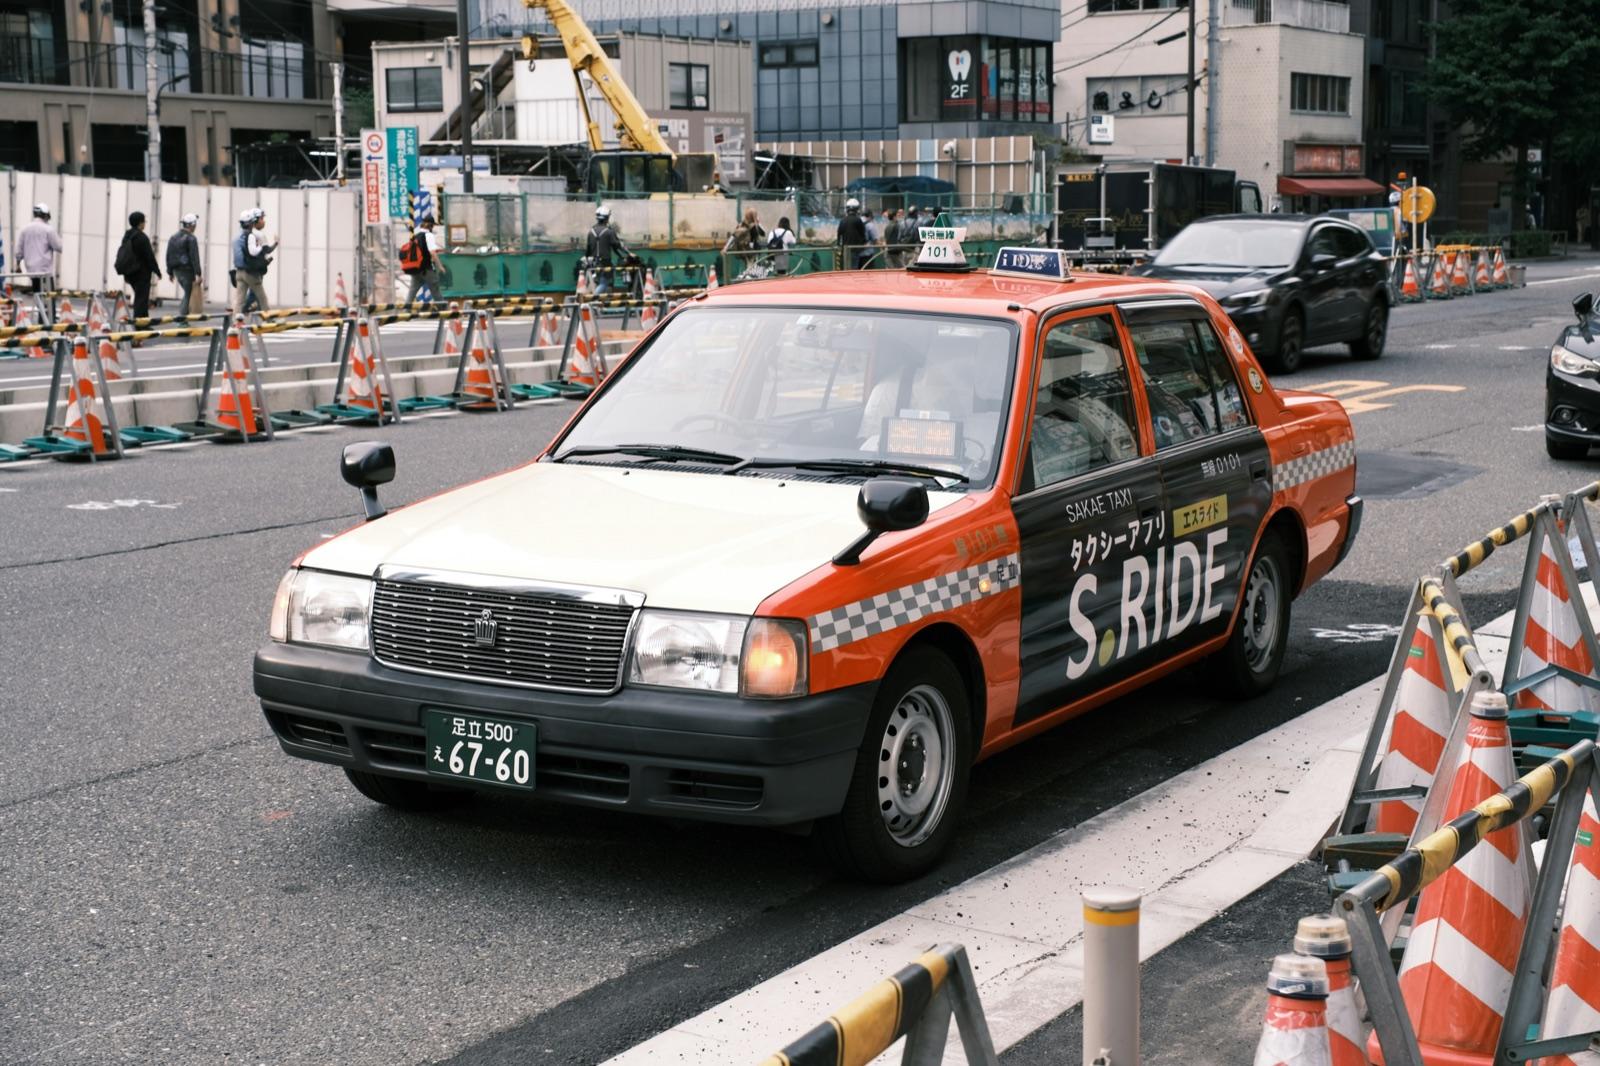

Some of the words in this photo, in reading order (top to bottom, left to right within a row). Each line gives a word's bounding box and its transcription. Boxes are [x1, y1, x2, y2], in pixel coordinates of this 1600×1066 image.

[951, 84, 969, 99] 2F
[927, 246, 948, 258] 101
[1065, 495, 1107, 524] SAKAE
[1106, 487, 1133, 511] TAXI
[1183, 502, 1220, 529] エスライド
[451, 716, 483, 739] 足立
[484, 721, 514, 743] 500
[433, 745, 445, 762] え
[449, 740, 530, 785] 67-60
